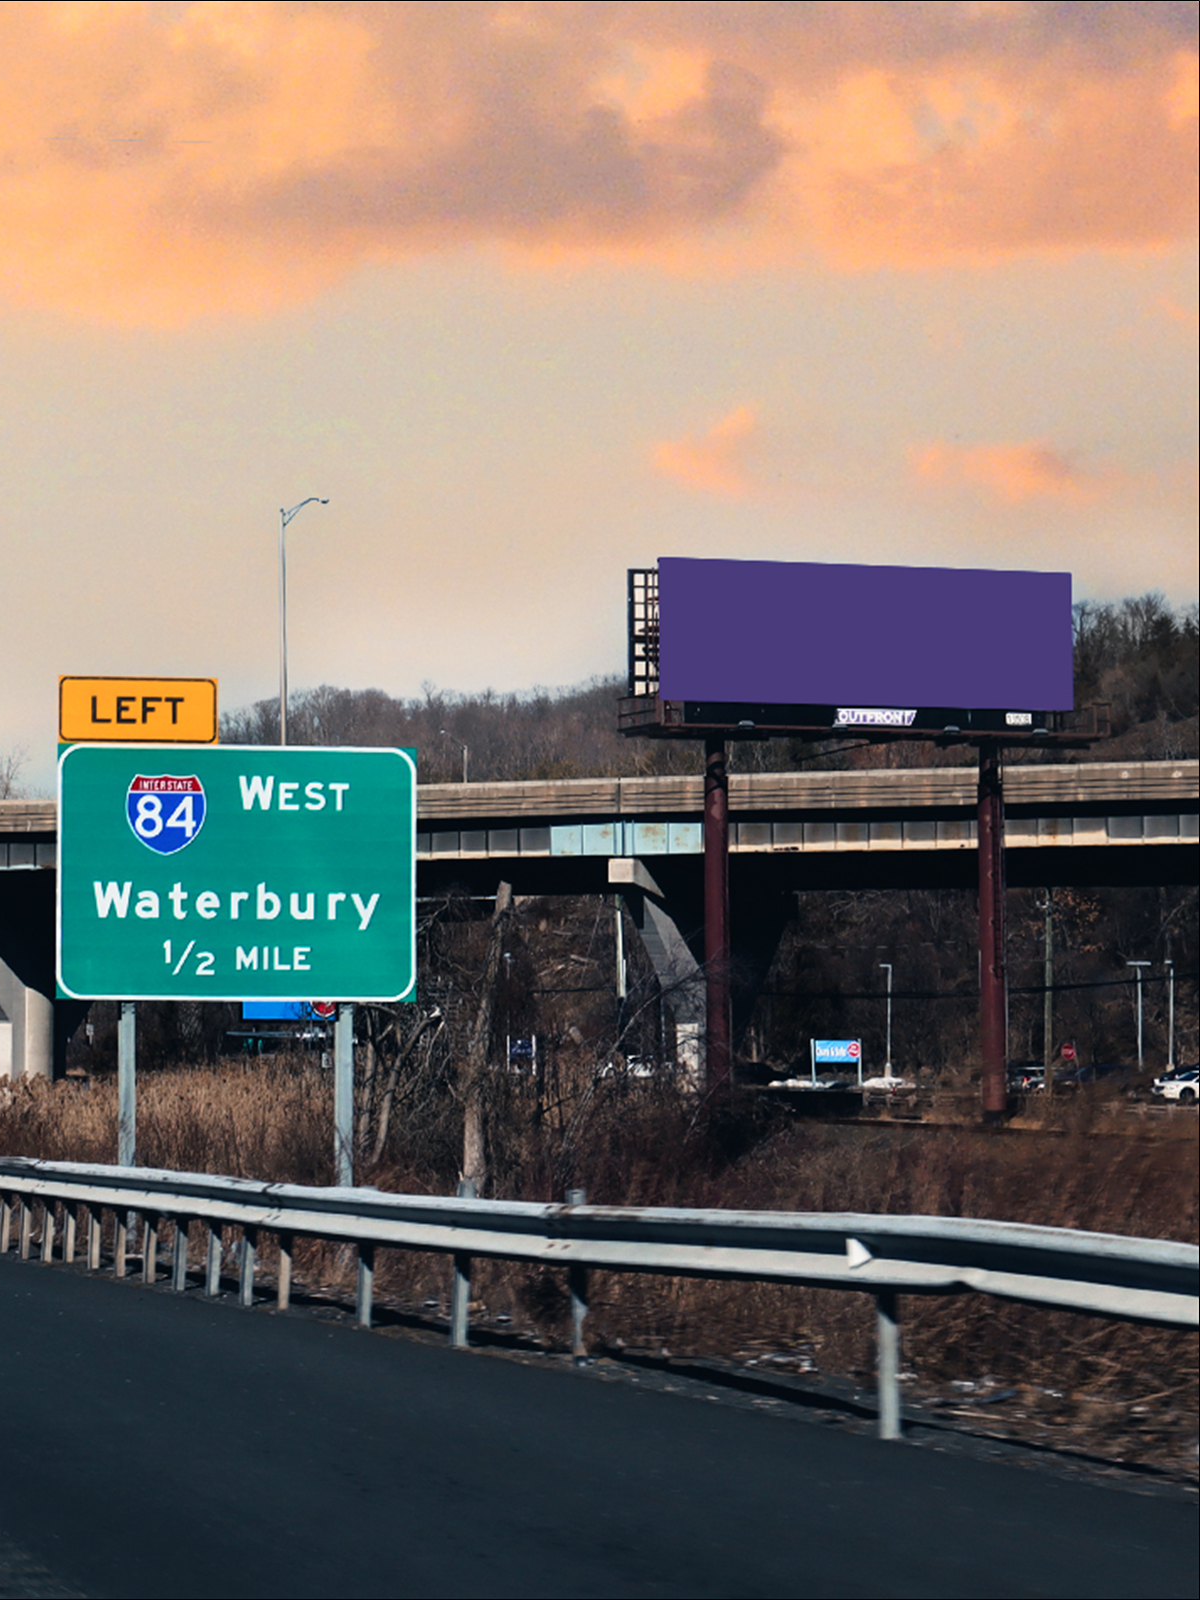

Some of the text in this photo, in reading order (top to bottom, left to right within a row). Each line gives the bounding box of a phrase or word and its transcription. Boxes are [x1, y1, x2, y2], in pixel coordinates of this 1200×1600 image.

[91, 696, 185, 724] LEFT
[139, 780, 193, 791] INTERSTATE
[135, 776, 349, 838] 84 WEST
[93, 881, 380, 930] Waterbury
[163, 939, 311, 976] 1/2 MILE
